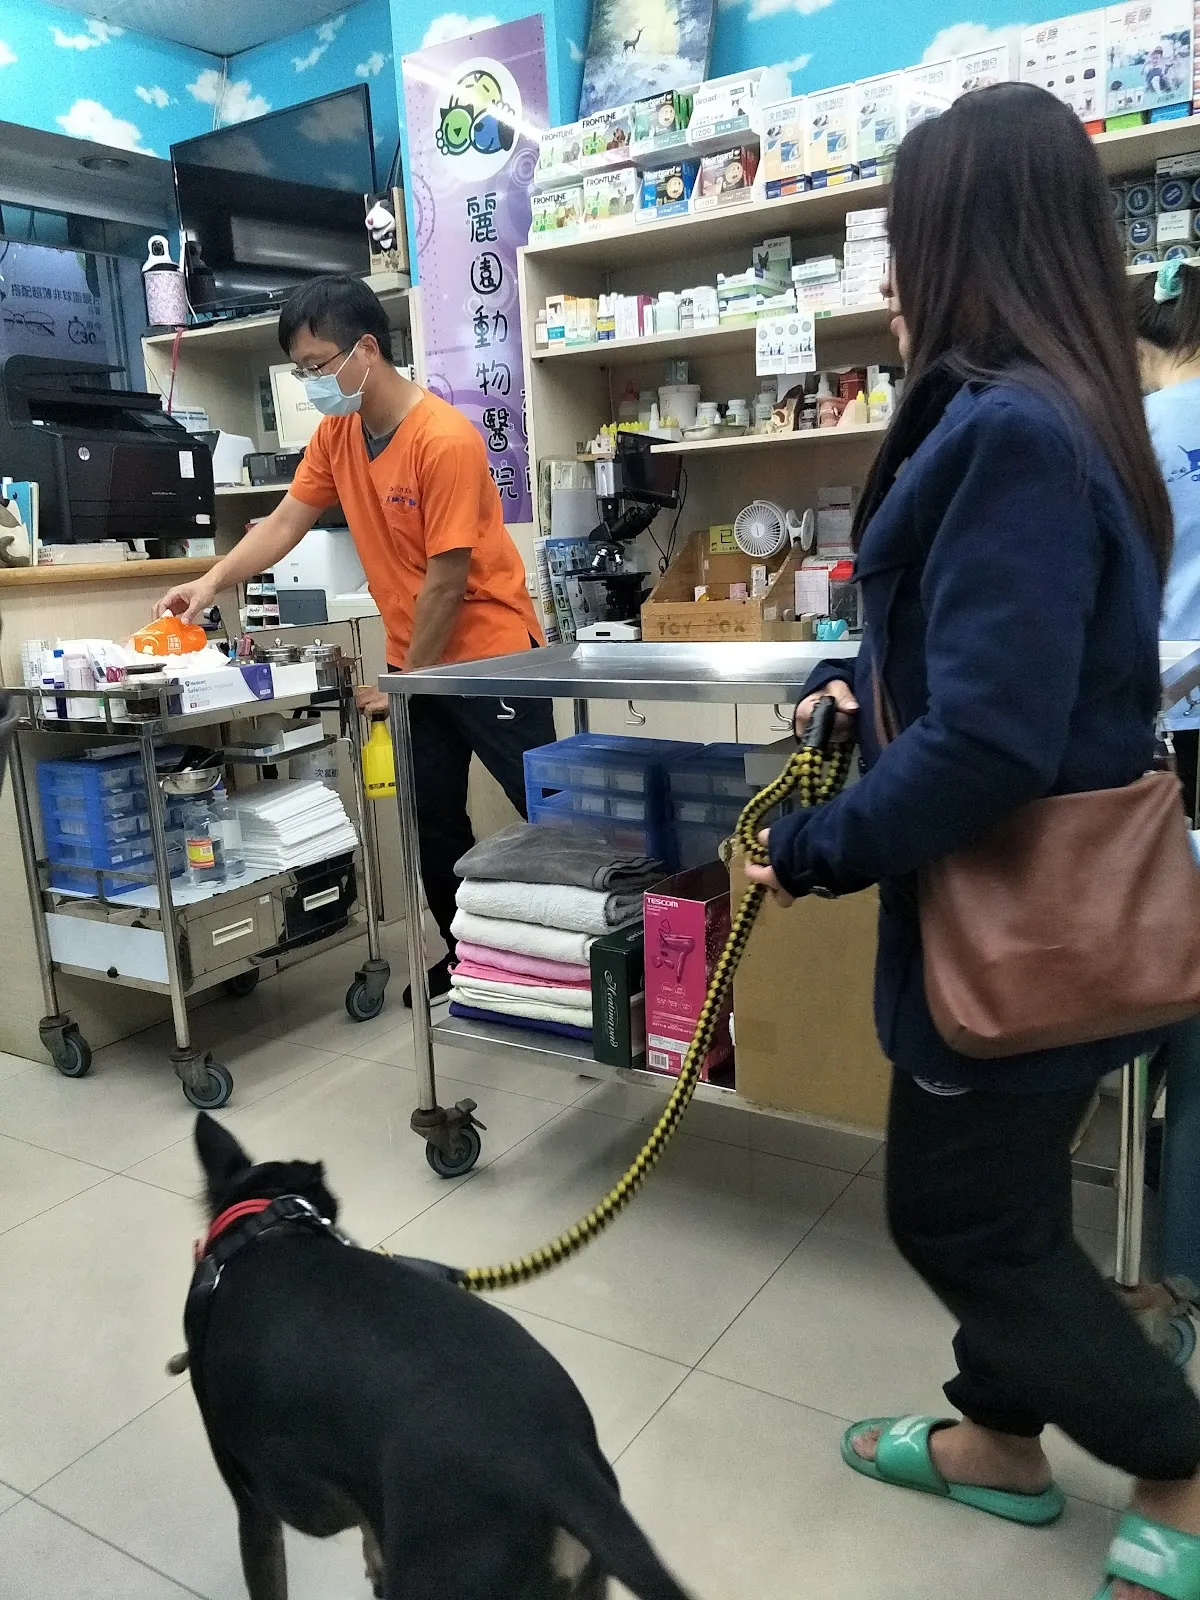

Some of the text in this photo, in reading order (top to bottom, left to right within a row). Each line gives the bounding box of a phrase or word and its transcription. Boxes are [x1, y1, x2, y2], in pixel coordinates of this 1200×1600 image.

[583, 111, 616, 128] FRONTLINE
[586, 173, 621, 187] FRONTLINE
[533, 192, 566, 205] FRONTLINE
[80, 331, 97, 344] 30
[296, 401, 315, 411] IDE
